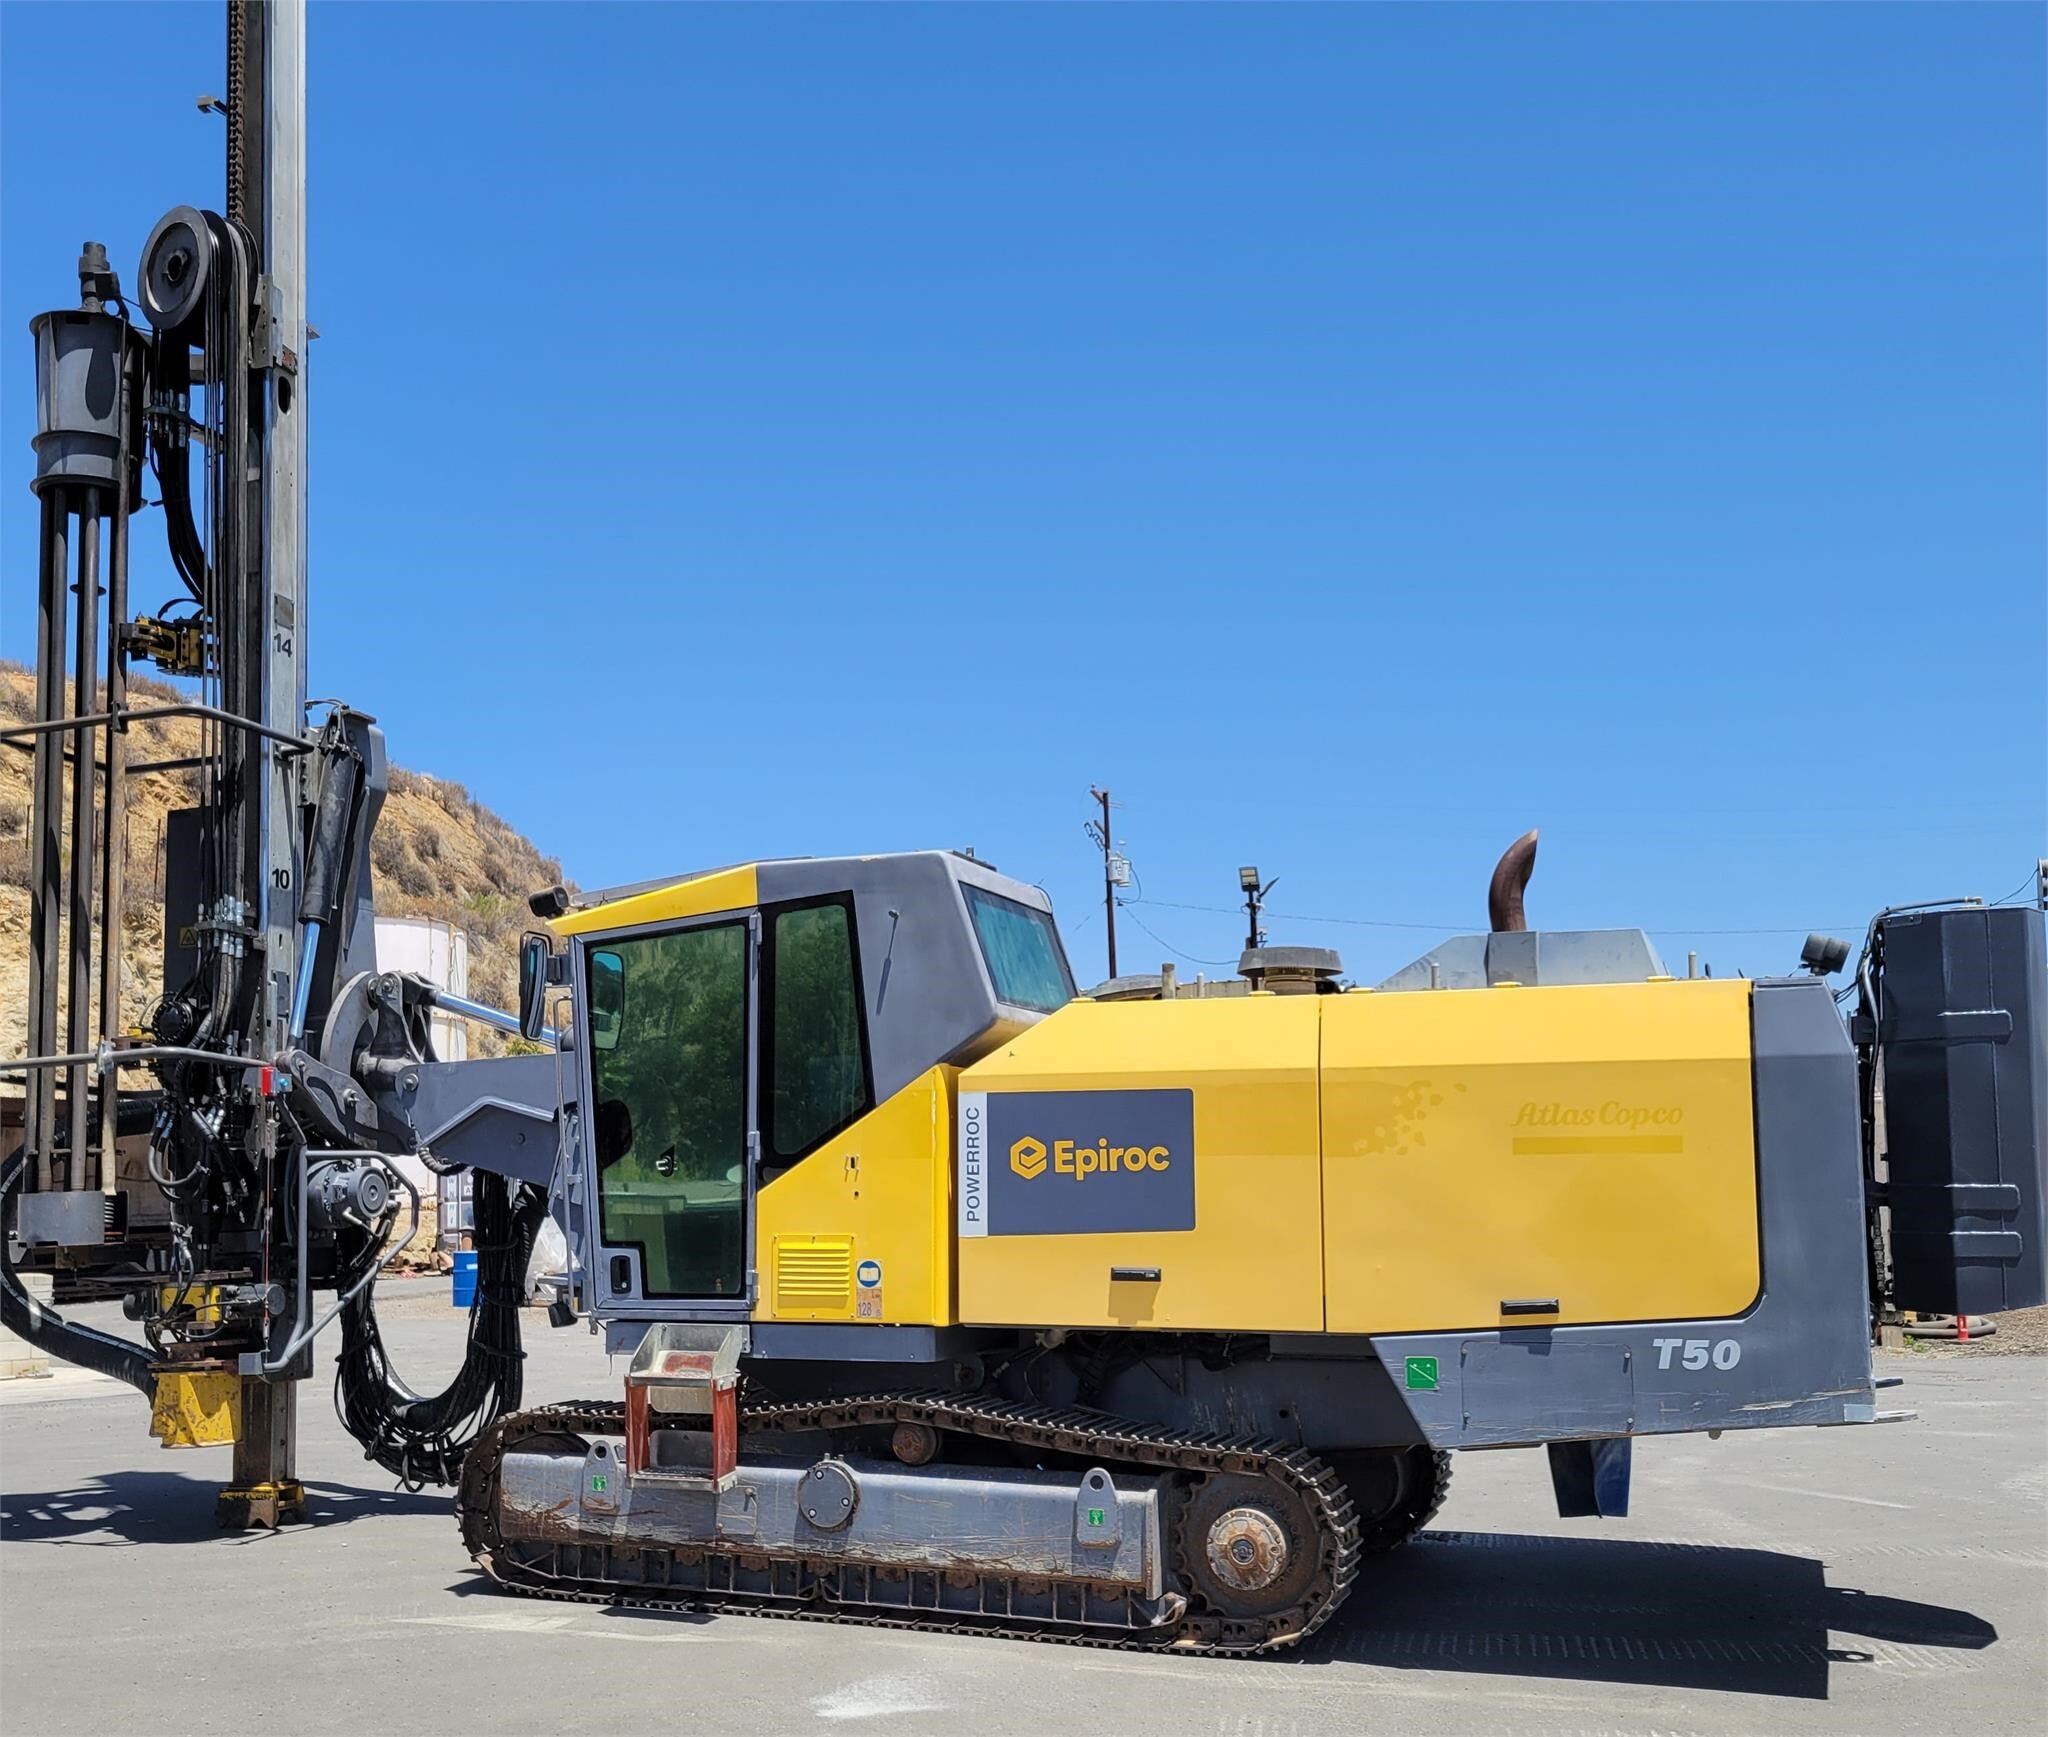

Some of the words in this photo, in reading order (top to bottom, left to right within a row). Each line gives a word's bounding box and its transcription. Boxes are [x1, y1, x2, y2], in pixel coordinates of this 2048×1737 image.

[273, 632, 293, 658] 14
[272, 868, 290, 890] 10
[1510, 1101, 1595, 1127] Atlas
[1599, 1100, 1684, 1130] Copco
[966, 1107, 980, 1222] POWERROC
[1054, 1137, 1170, 1181] Epiroc
[858, 1301, 872, 1317] 128
[1652, 1338, 1741, 1371] T50
